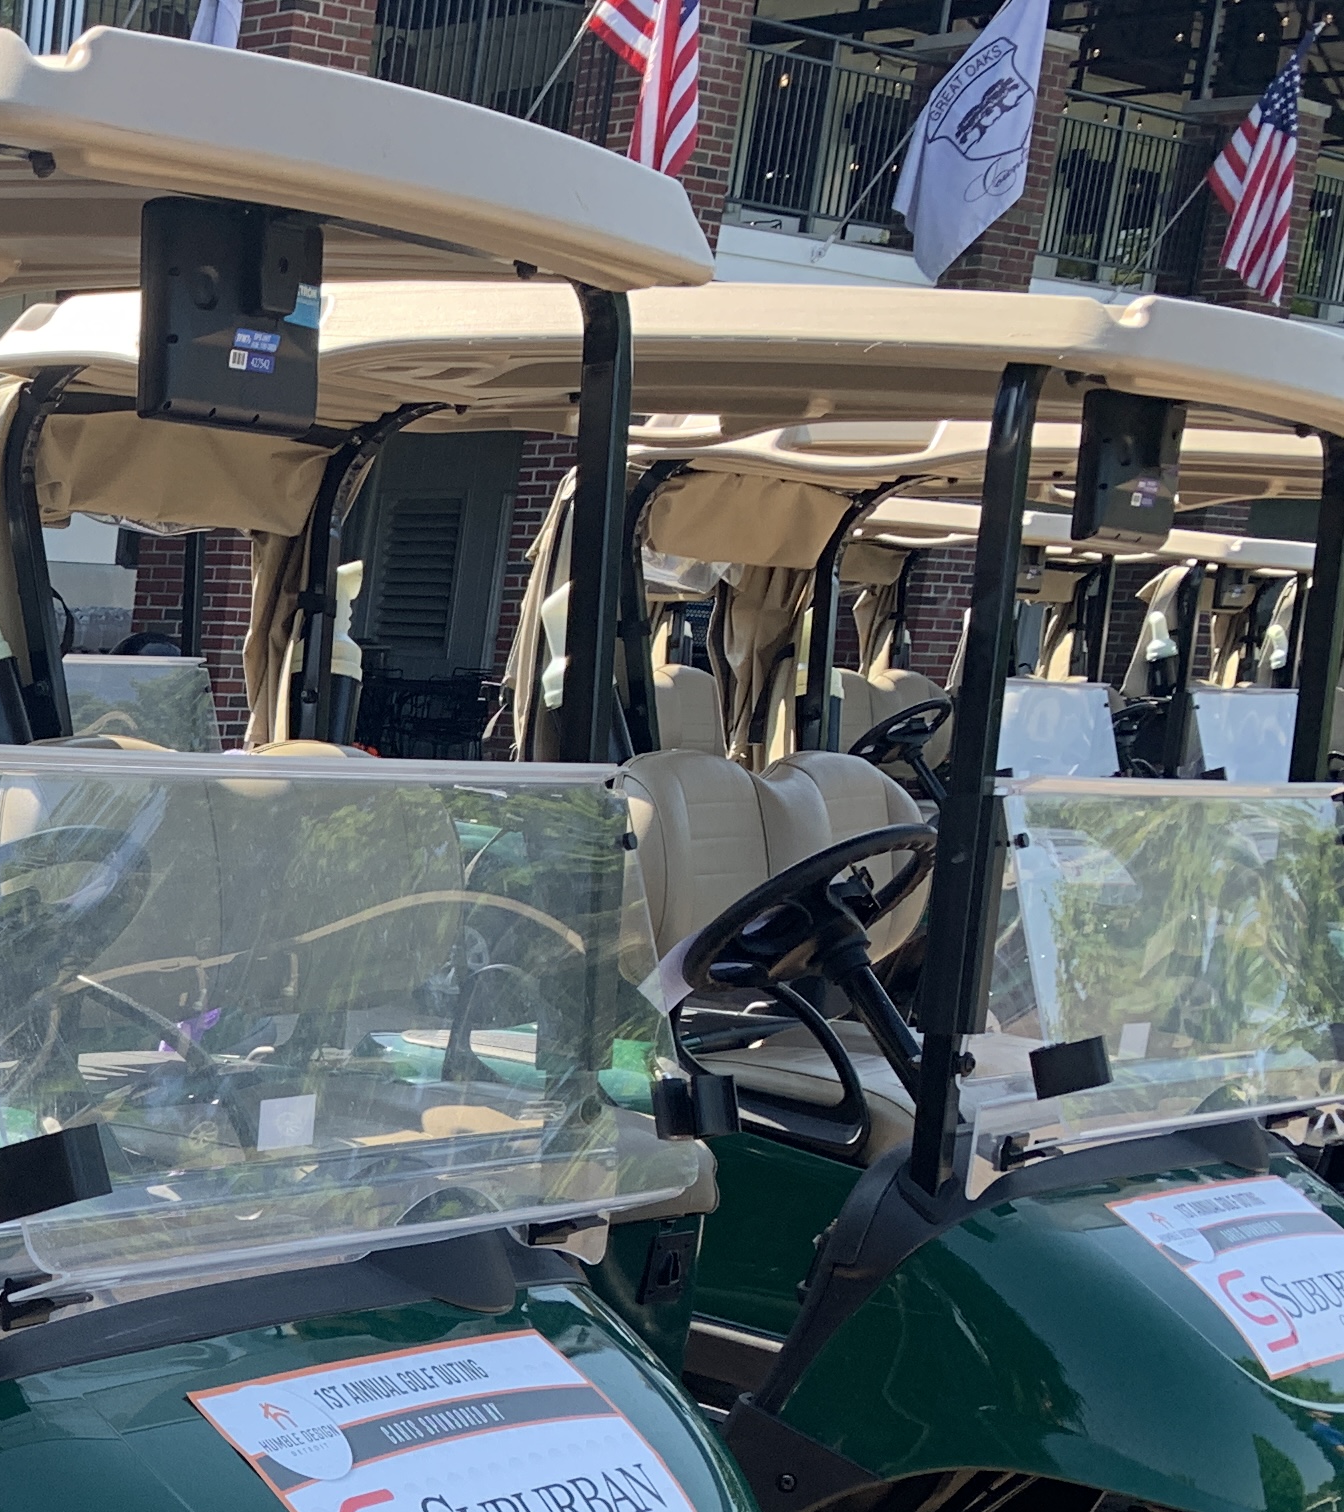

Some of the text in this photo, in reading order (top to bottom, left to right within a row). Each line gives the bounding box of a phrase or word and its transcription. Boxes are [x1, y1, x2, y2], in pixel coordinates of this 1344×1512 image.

[929, 44, 1002, 122] GREAT OAKS
[298, 284, 318, 298] TRON
[1260, 1270, 1344, 1319] SUBUR
[313, 1358, 489, 1410] 1ST ANNUAL GOLF OUTING
[258, 1424, 340, 1454] HUMBLE DESIGN
[379, 1420, 424, 1445] CARTS
[484, 1402, 506, 1422] BY
